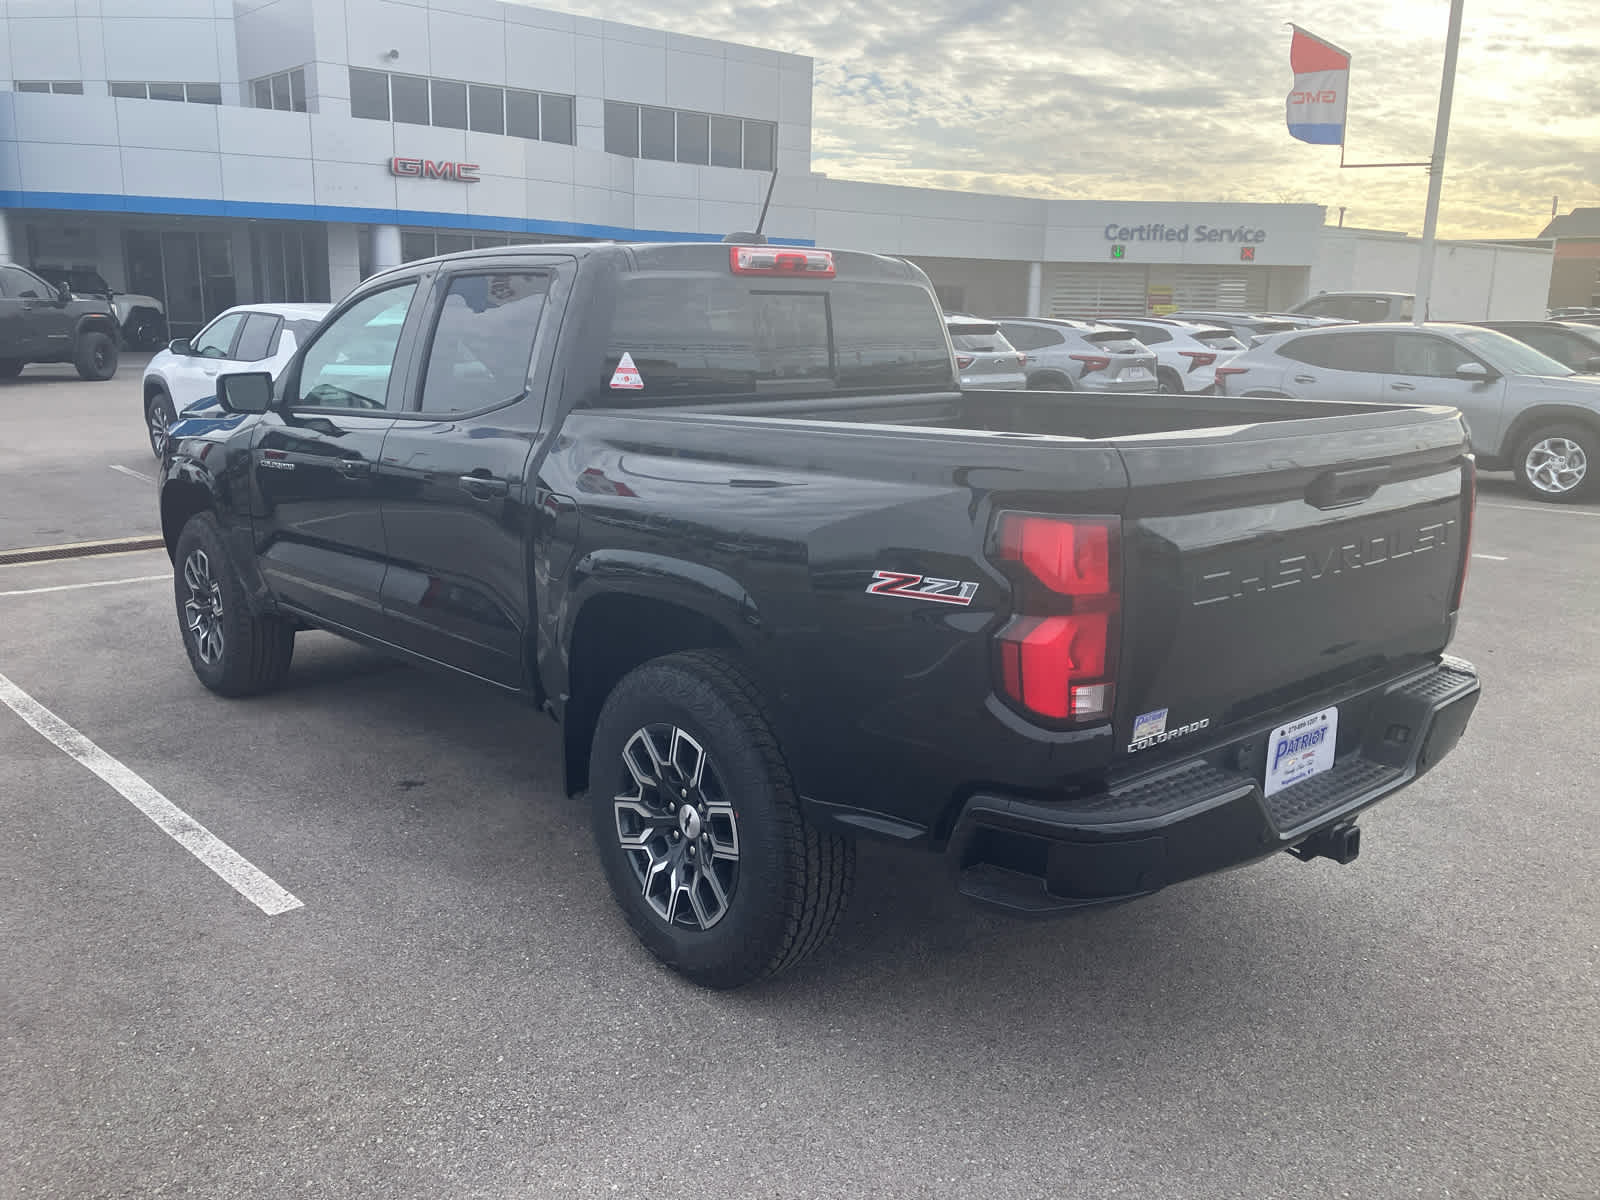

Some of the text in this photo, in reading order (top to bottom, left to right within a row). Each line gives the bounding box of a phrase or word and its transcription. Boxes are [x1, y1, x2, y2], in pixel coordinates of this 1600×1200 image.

[390, 157, 480, 182] GMC
[1104, 223, 1266, 243] Certified Service
[1193, 519, 1456, 606] CHEVROLET
[865, 570, 979, 606] Z71
[1127, 718, 1210, 753] COLORADO
[1273, 726, 1329, 770] PATRIOT
